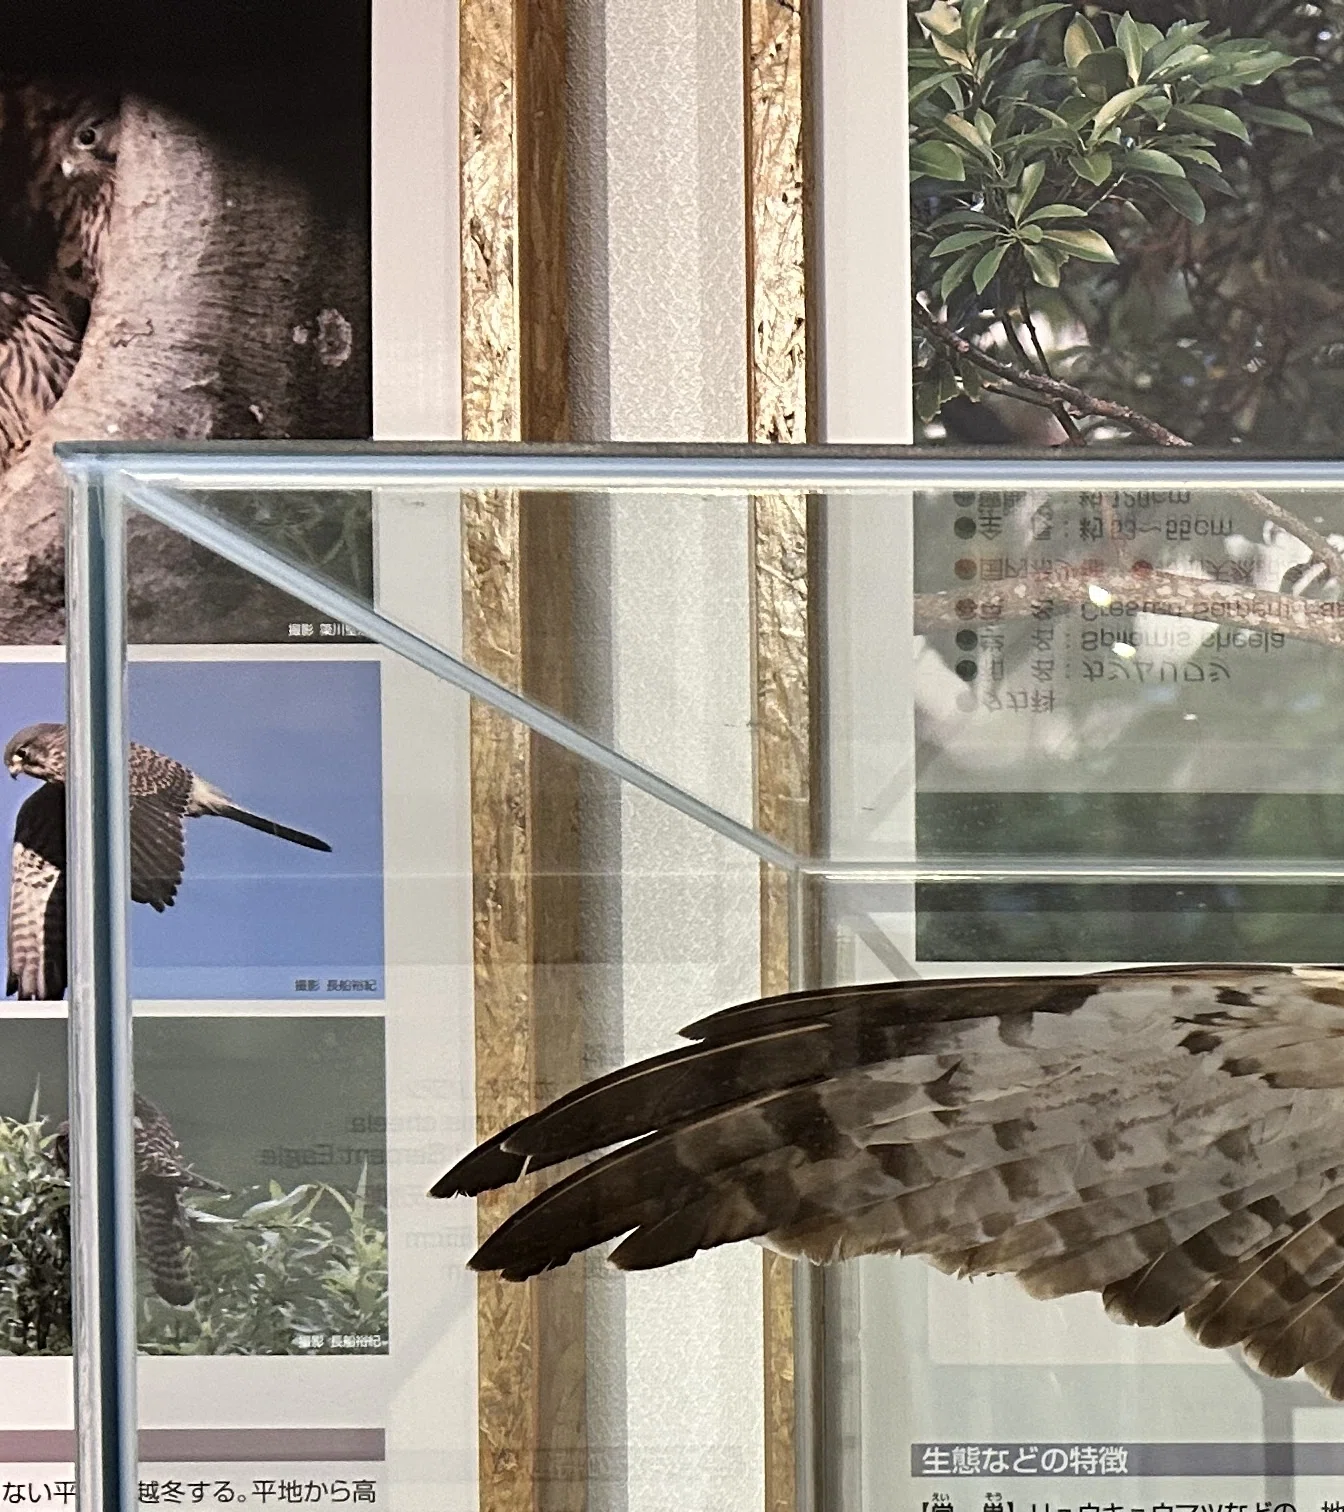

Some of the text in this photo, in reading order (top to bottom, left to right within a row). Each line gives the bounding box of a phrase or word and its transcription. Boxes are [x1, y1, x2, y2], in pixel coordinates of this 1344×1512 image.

[921, 1446, 1129, 1475] 生態などの特徴
